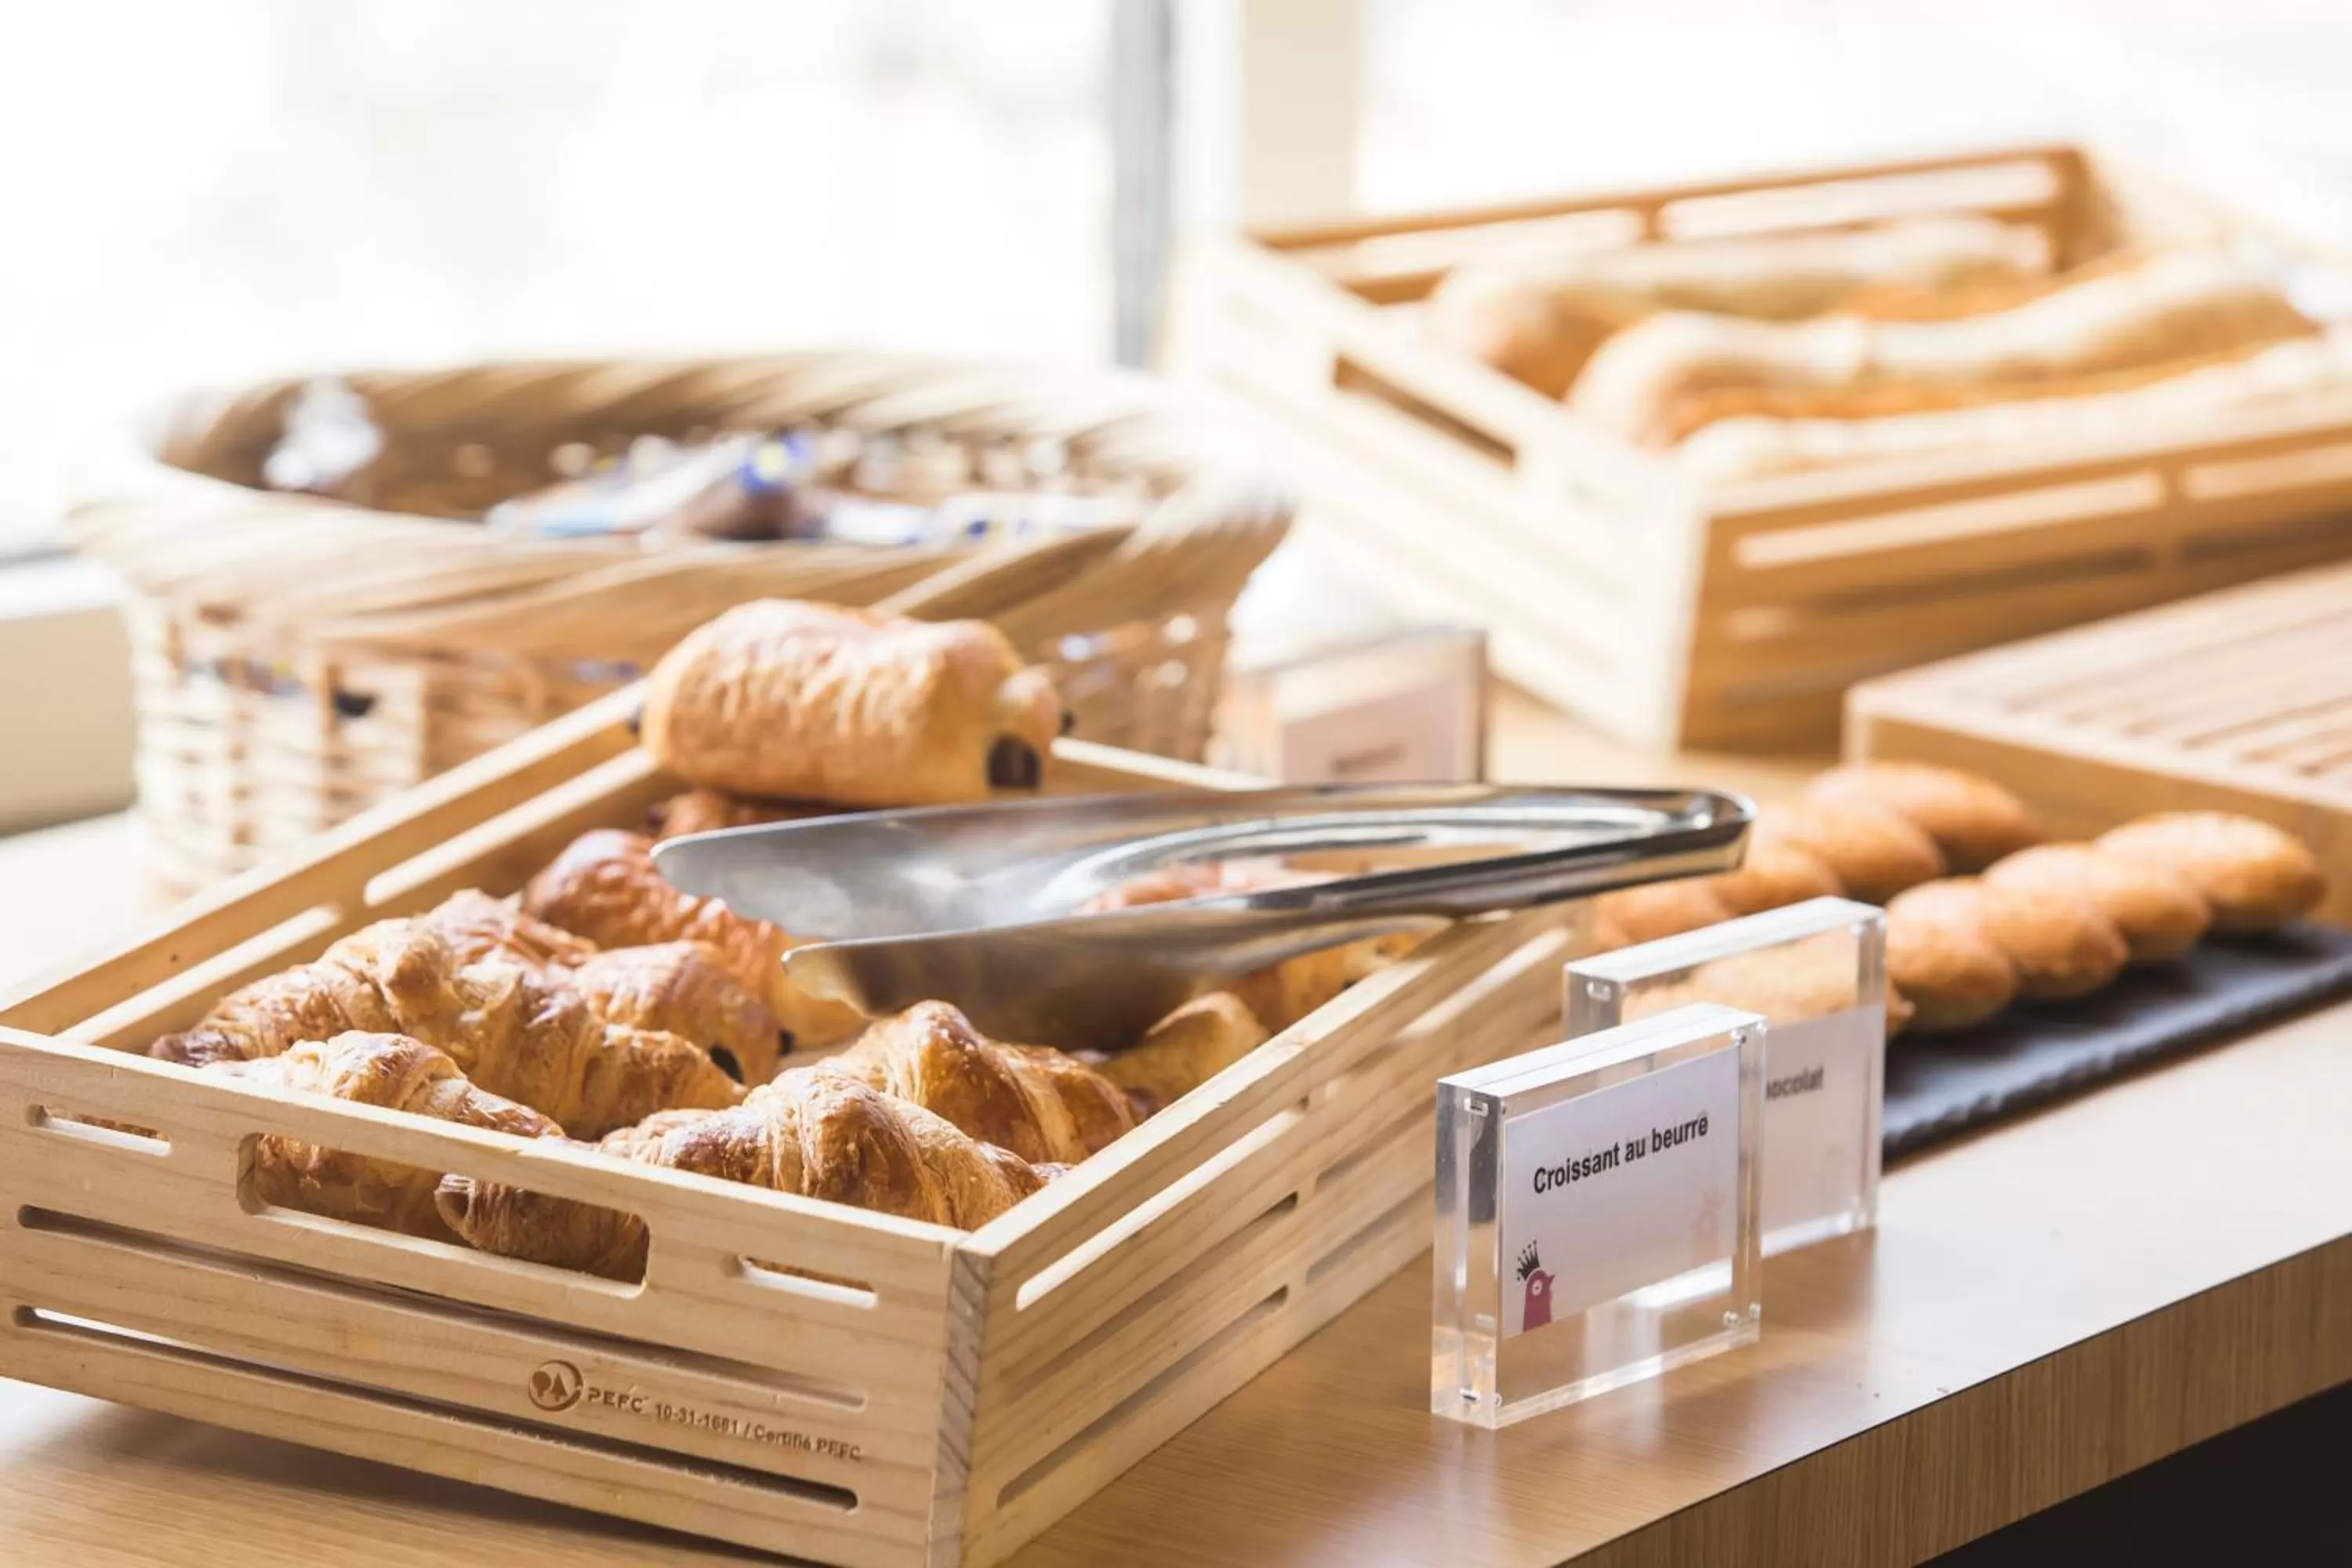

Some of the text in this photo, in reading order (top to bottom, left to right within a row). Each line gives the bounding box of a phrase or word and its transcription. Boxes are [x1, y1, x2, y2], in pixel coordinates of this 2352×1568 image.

[1534, 1115, 1708, 1194] Croissant au beurre
[588, 1387, 643, 1413] PEFC
[816, 1436, 861, 1461] PEFC
